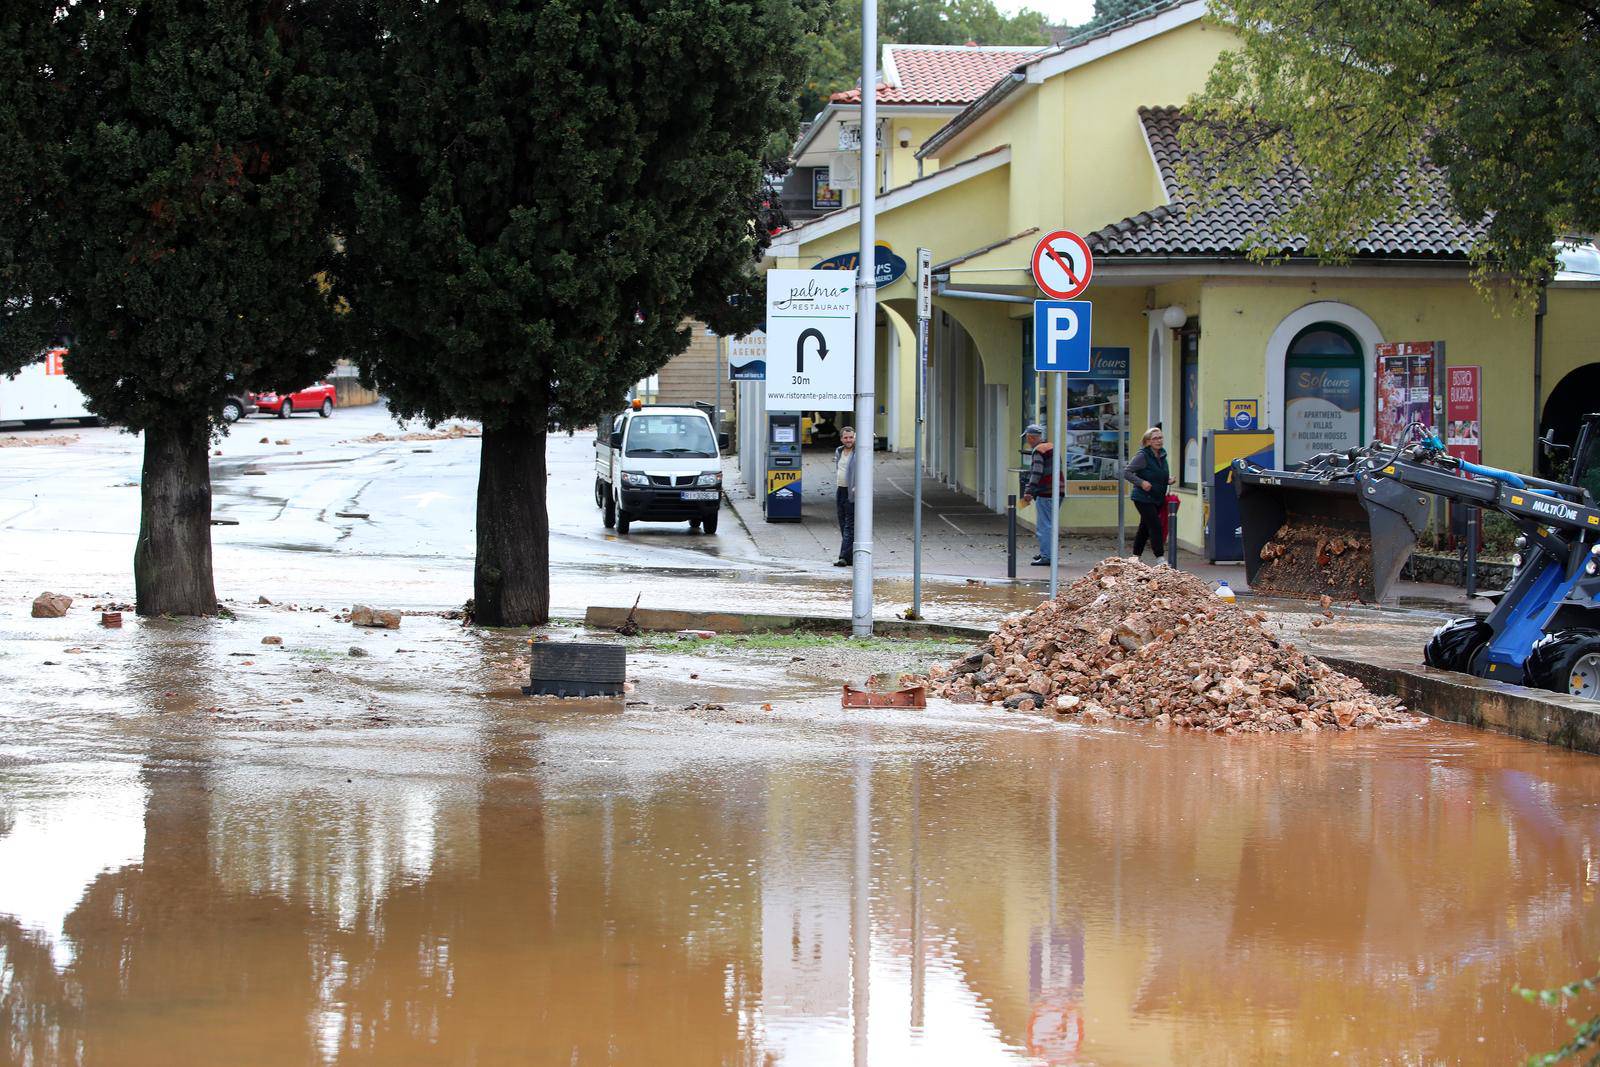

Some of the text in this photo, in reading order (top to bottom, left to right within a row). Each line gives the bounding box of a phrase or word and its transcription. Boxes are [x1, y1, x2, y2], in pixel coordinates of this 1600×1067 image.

[777, 278, 841, 310] palma
[1047, 308, 1078, 364] P
[791, 375, 810, 385] 30m
[768, 392, 852, 400] www.ristorante-palma.com
[1304, 411, 1342, 419] APARTMENTS
[1298, 432, 1348, 440] HOLIDAY HOUSES
[1312, 442, 1333, 450] ROOMS
[774, 472, 796, 481] ATM
